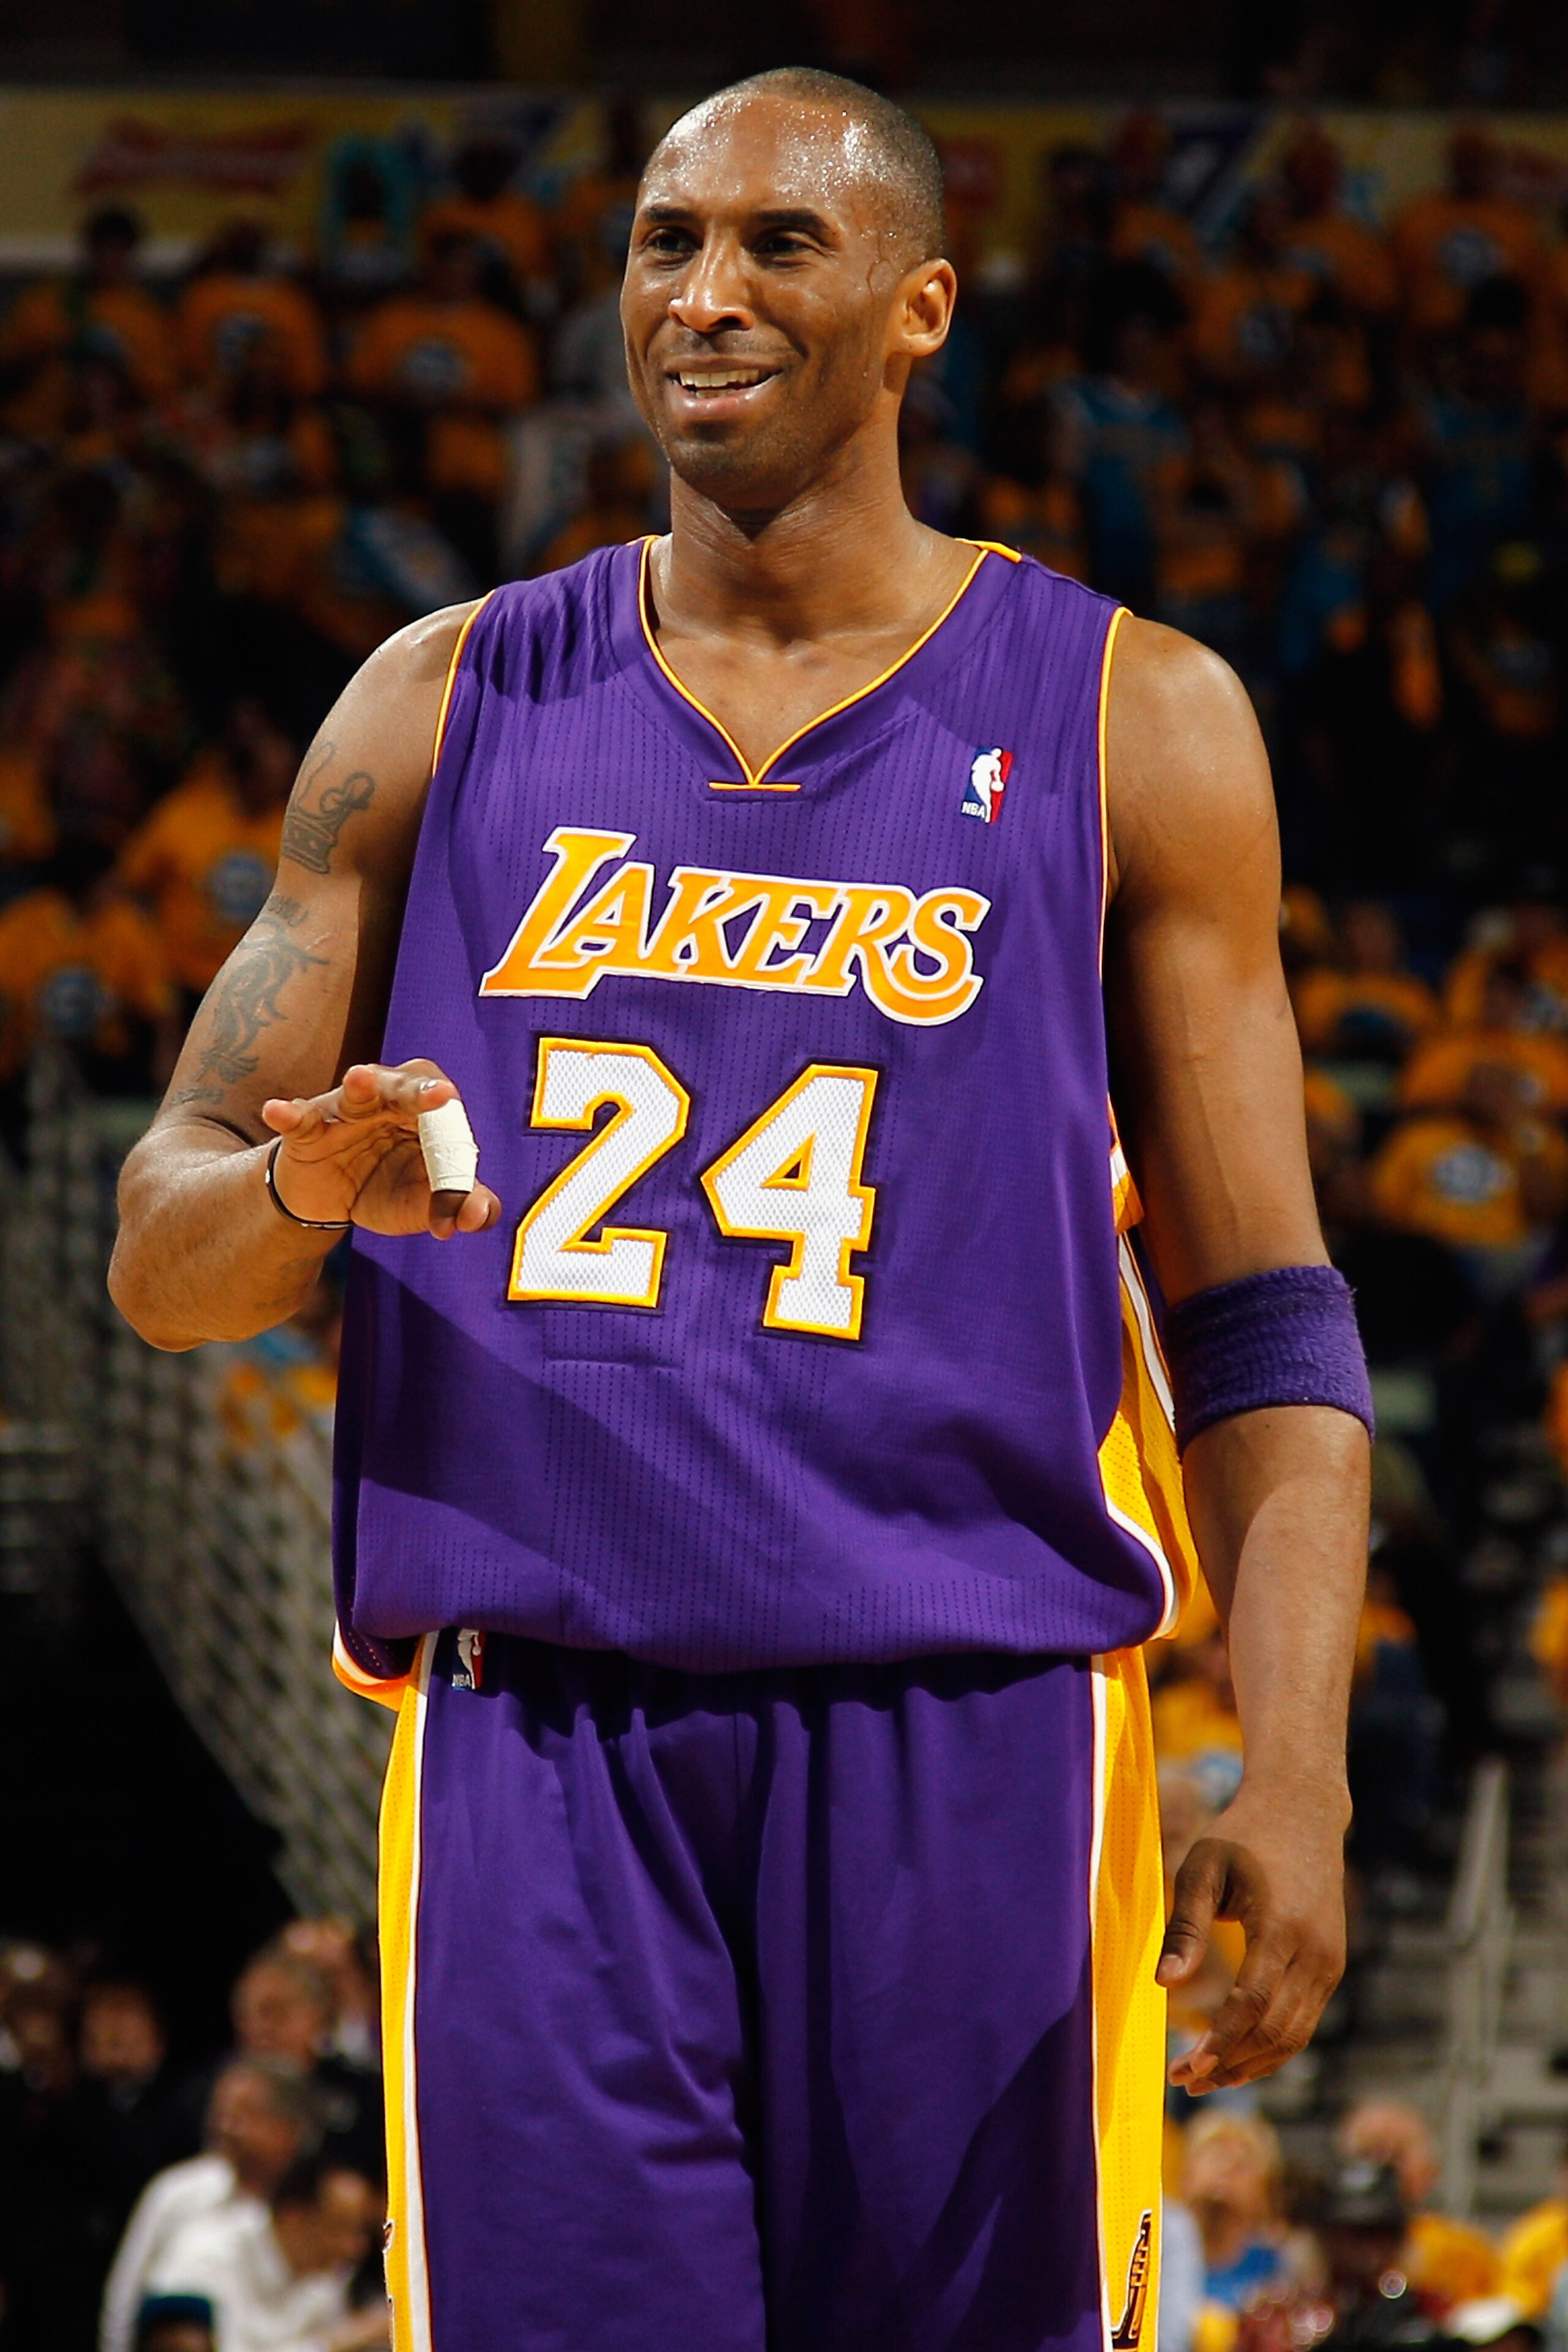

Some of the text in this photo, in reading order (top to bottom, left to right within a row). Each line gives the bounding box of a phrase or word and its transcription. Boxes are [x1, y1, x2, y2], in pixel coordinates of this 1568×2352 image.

[961, 801, 985, 818] NBA
[478, 827, 992, 1026] LAKERS
[507, 1036, 878, 1341] 24
